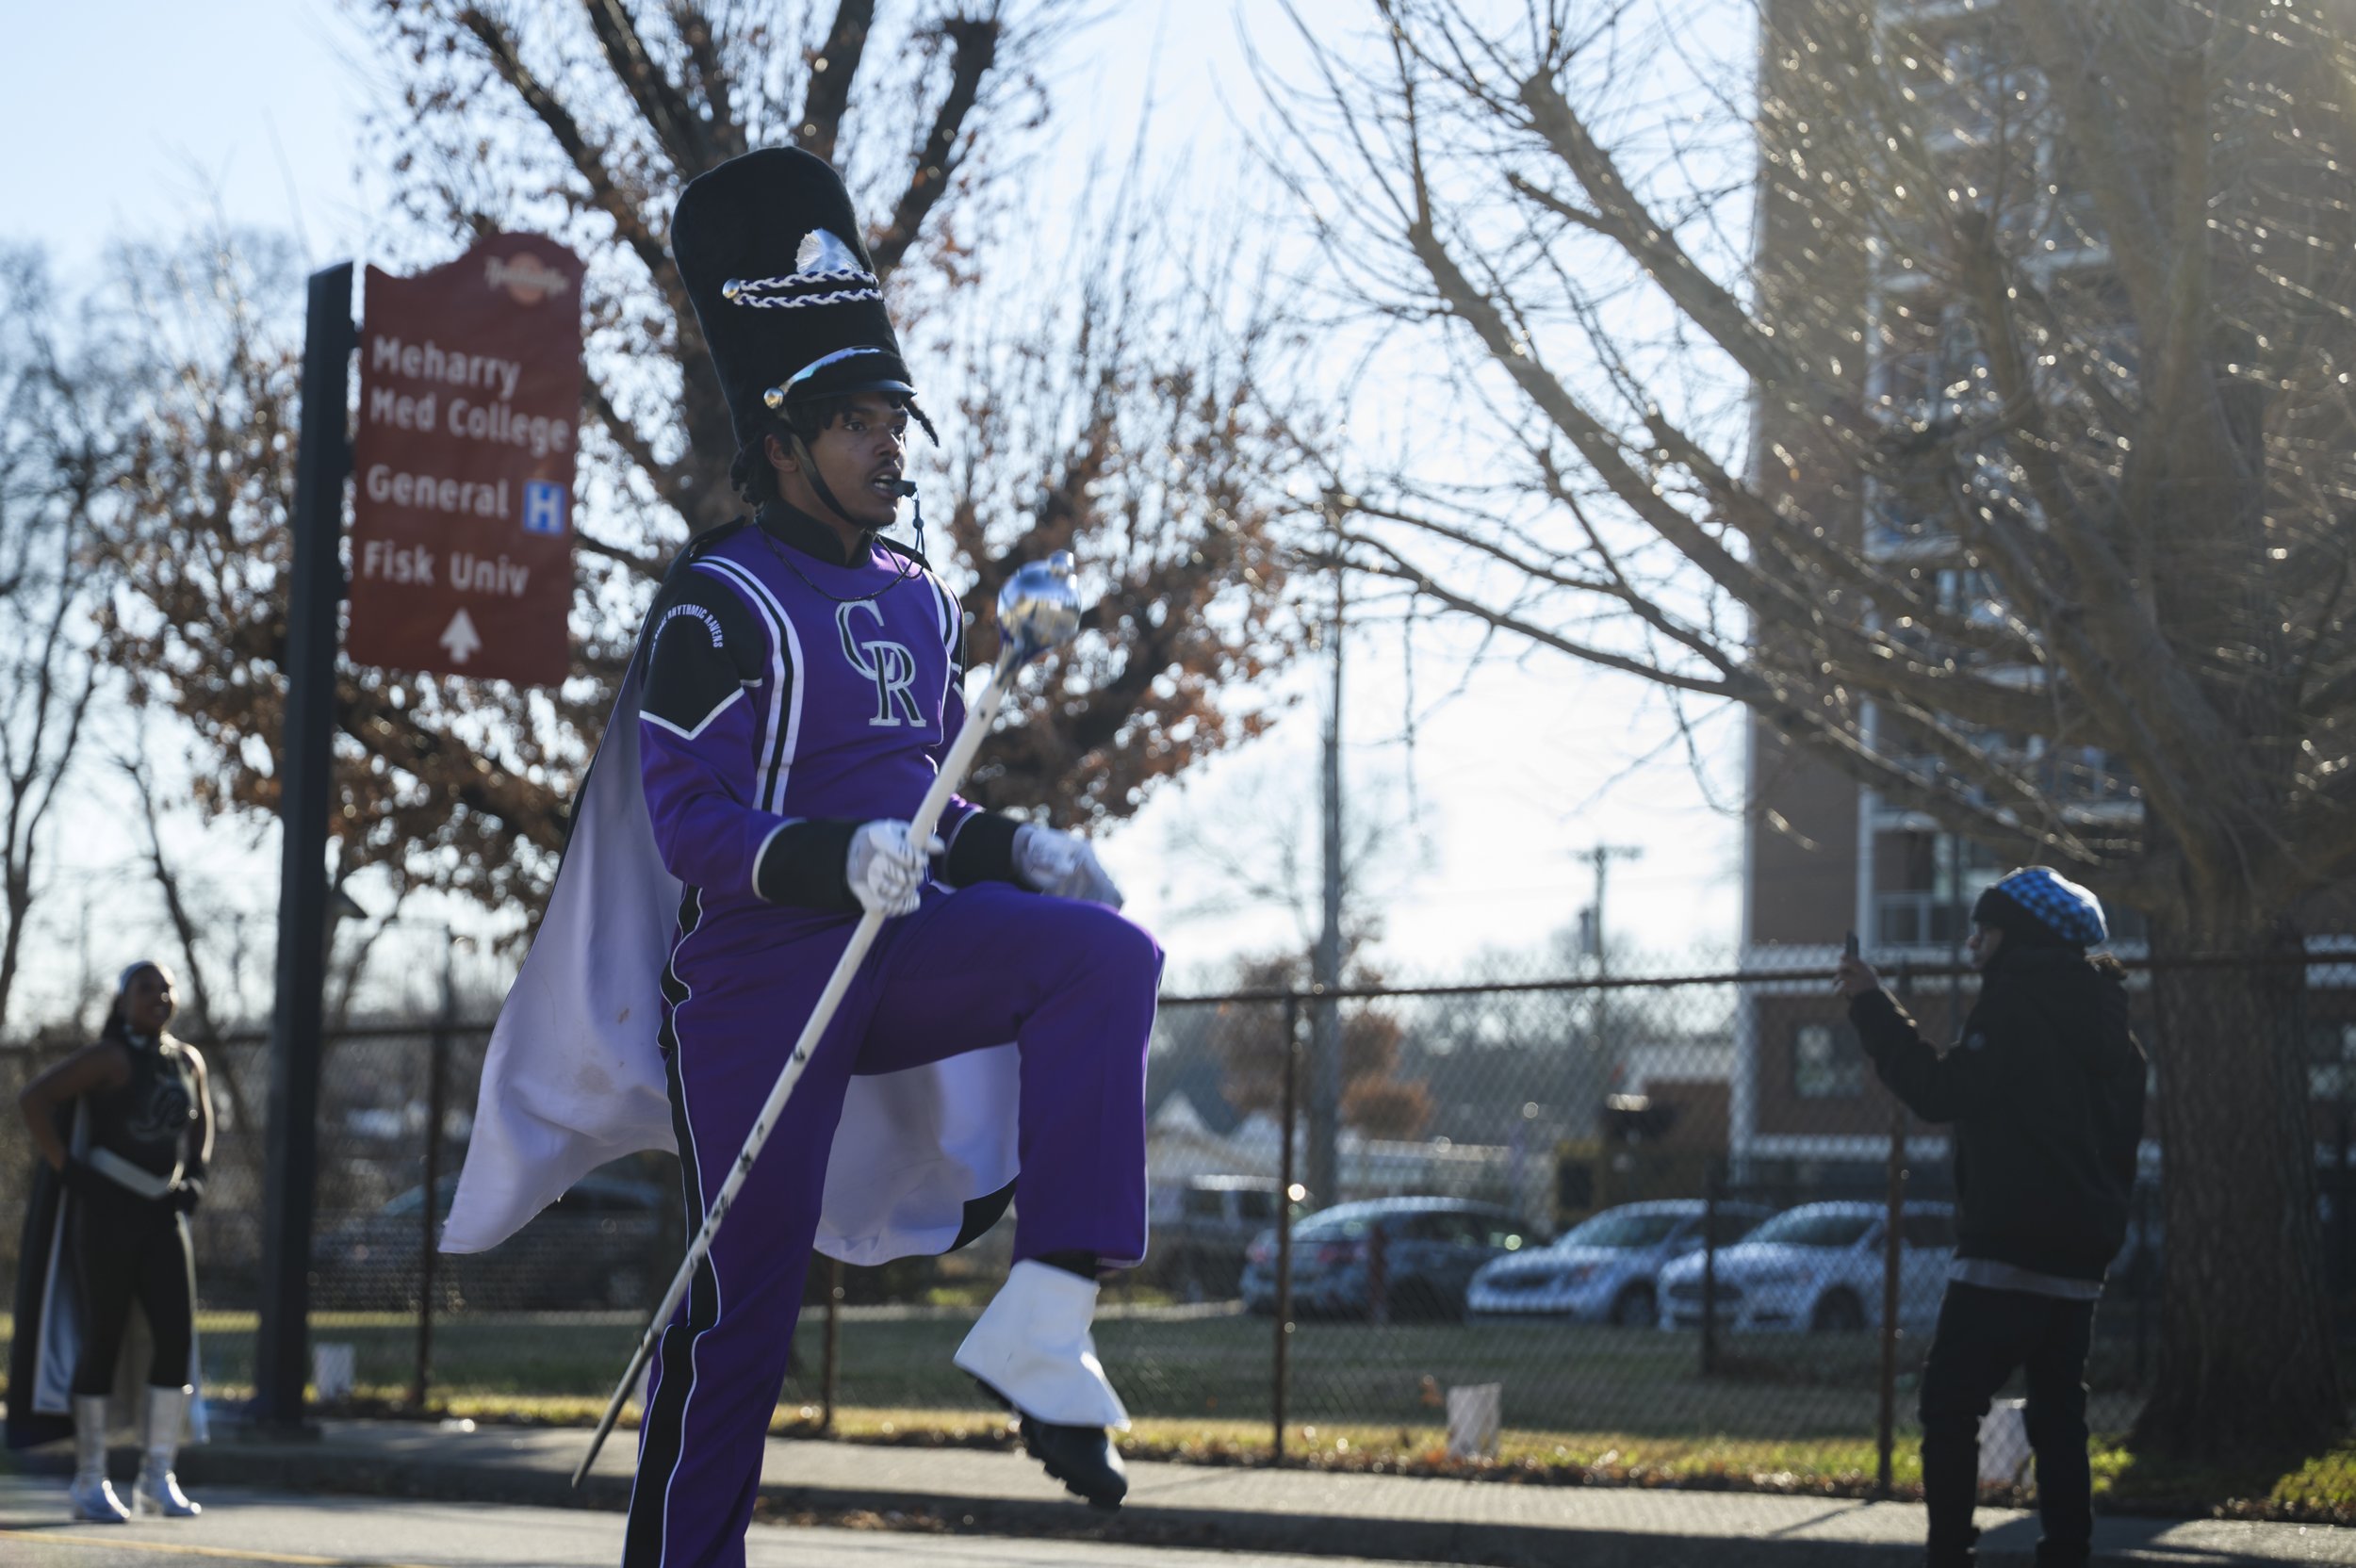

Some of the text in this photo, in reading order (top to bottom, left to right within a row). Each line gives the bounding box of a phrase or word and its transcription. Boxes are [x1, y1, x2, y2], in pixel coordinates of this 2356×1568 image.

[372, 335, 520, 400] Meharry
[369, 387, 570, 458] Med College
[367, 465, 563, 530] General H
[363, 541, 530, 596] Fisk Univ
[667, 604, 724, 648] RHYTHMIC RAVENS
